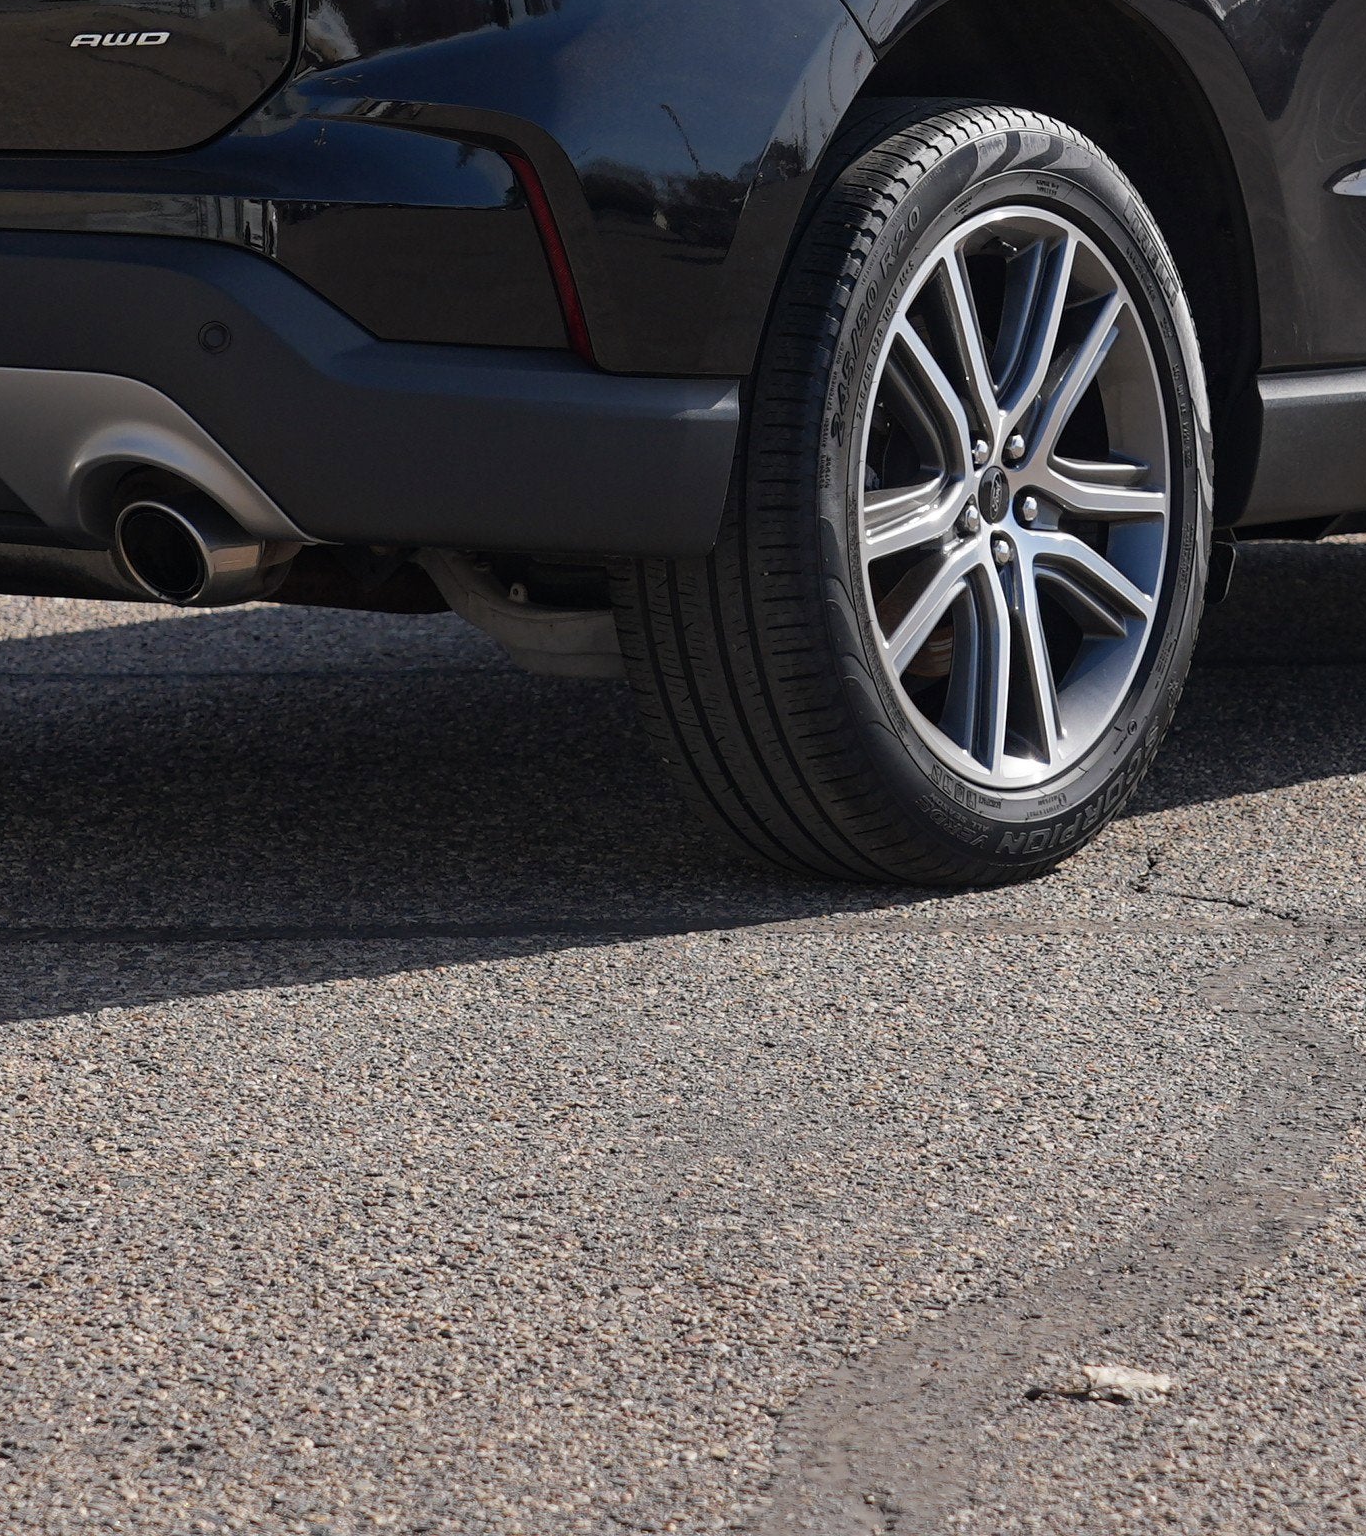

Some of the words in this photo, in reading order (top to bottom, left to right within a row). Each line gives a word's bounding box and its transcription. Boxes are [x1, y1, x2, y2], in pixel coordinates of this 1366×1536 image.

[70, 30, 171, 48] AWD
[830, 279, 879, 449] 245/50
[879, 205, 922, 280] R20
[995, 715, 1160, 855] SCORPION
